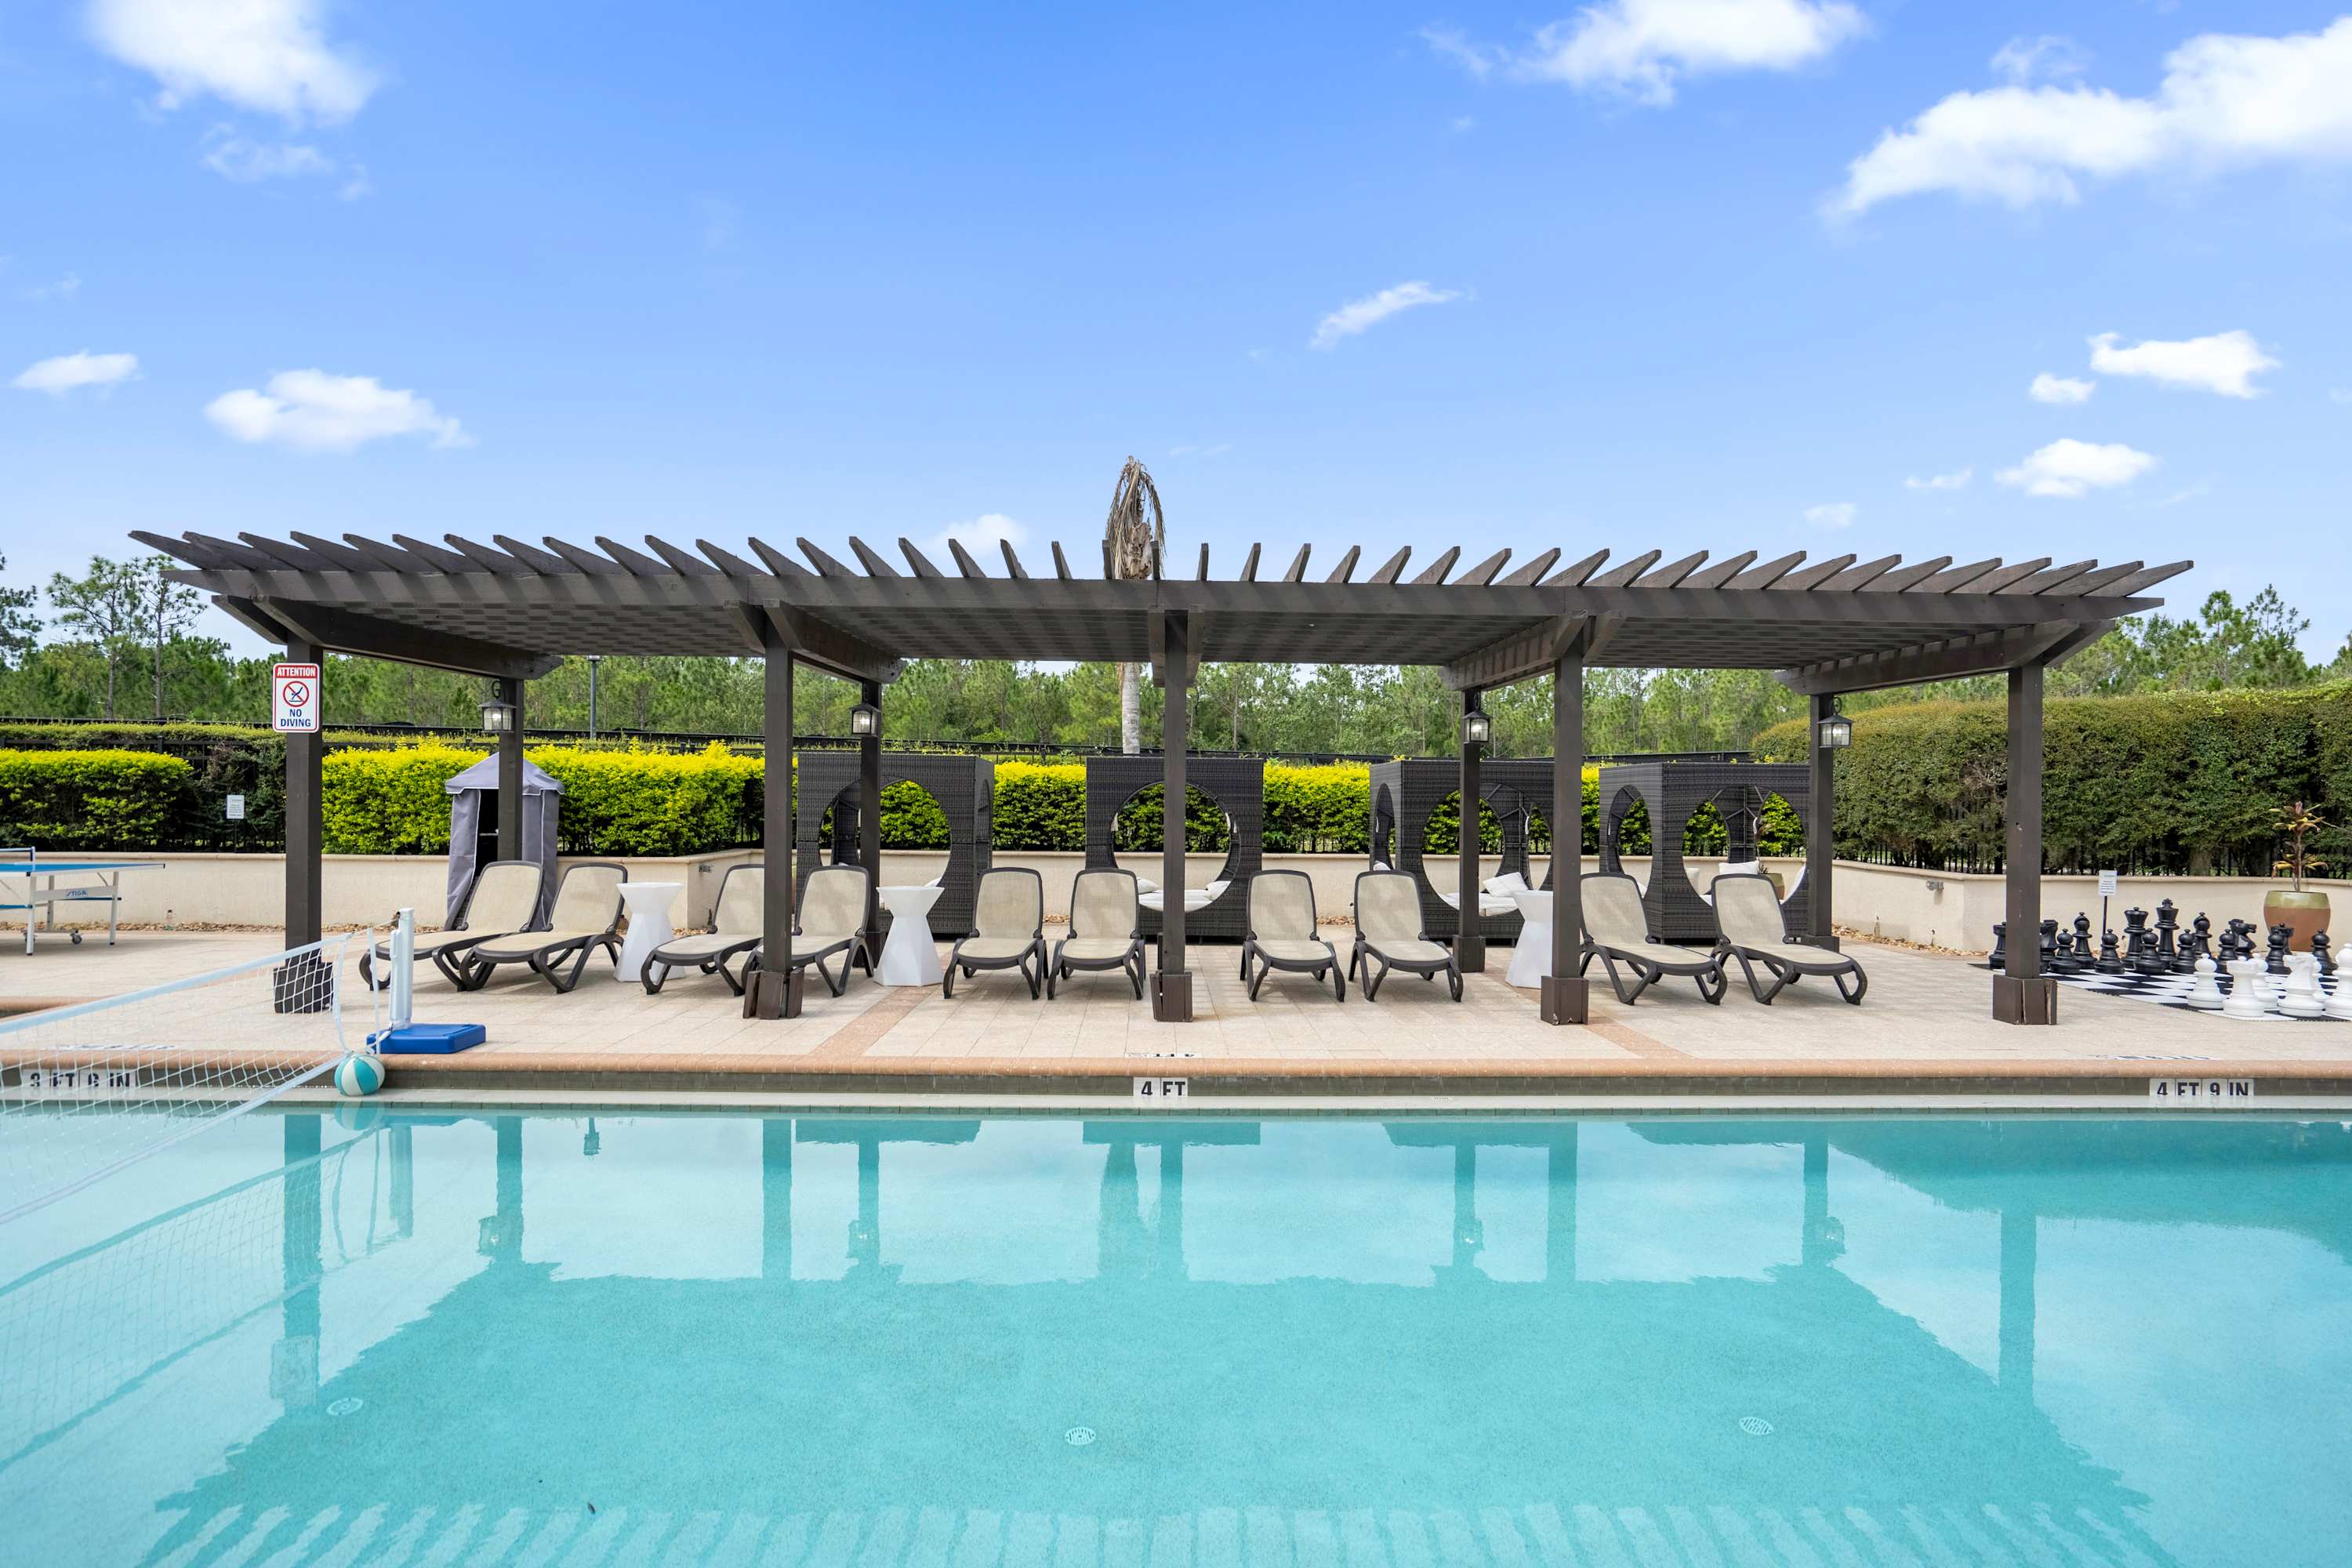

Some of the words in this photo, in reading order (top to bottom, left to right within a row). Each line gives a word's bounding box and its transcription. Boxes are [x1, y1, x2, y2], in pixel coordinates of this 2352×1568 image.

[277, 666, 315, 677] ATTENTION
[289, 709, 302, 717] NO
[280, 718, 311, 727] DIVING
[31, 1073, 40, 1087] 3
[53, 1073, 74, 1087] FT
[110, 1073, 129, 1087] IN
[1141, 1081, 1153, 1096] 4
[1163, 1081, 1186, 1096] FT
[2157, 1082, 2169, 1096] 4
[2177, 1082, 2199, 1096] FT
[2209, 1082, 2220, 1096] 9
[2229, 1082, 2249, 1096] IN
